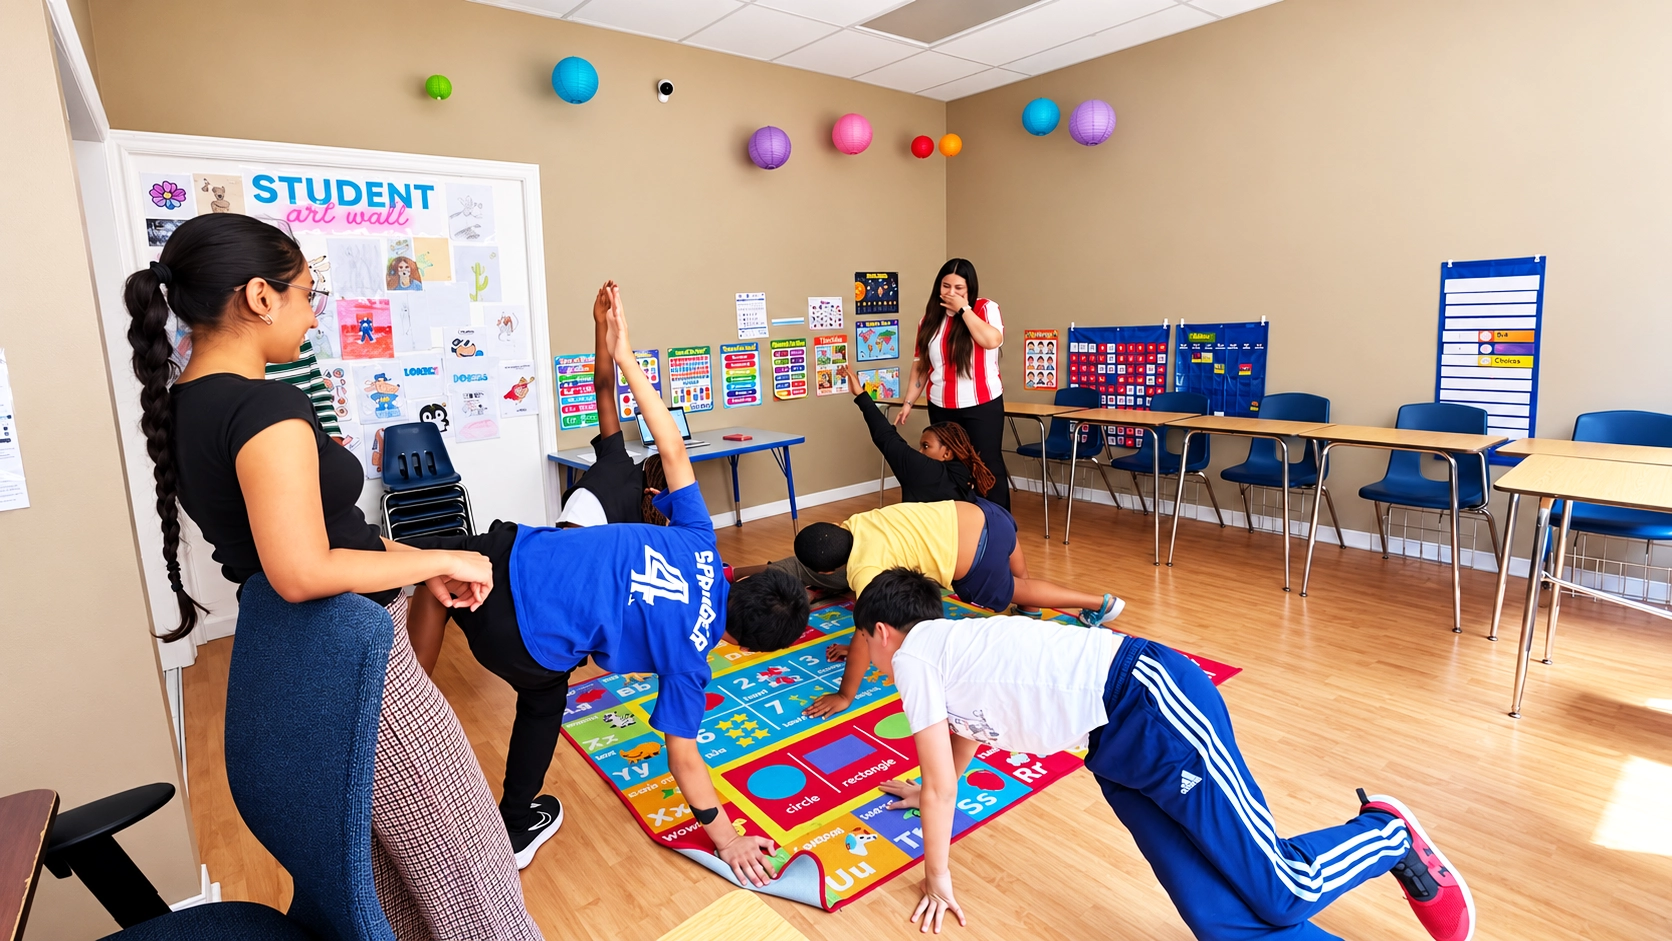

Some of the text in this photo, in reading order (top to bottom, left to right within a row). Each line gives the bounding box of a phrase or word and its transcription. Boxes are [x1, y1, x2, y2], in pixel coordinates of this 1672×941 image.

[252, 174, 434, 210] STUDENT
[346, 202, 409, 225] wall
[630, 544, 689, 606] 4
[799, 655, 819, 666] 3
[733, 677, 756, 690] 2
[764, 699, 784, 714] 7
[695, 728, 716, 744] 6
[612, 762, 649, 781] Yy
[842, 756, 897, 788] rectangle
[1012, 761, 1048, 783] Rr
[785, 793, 820, 815] circle
[957, 792, 997, 815] Ss
[647, 803, 692, 827] Xx
[825, 861, 876, 892] Uu
